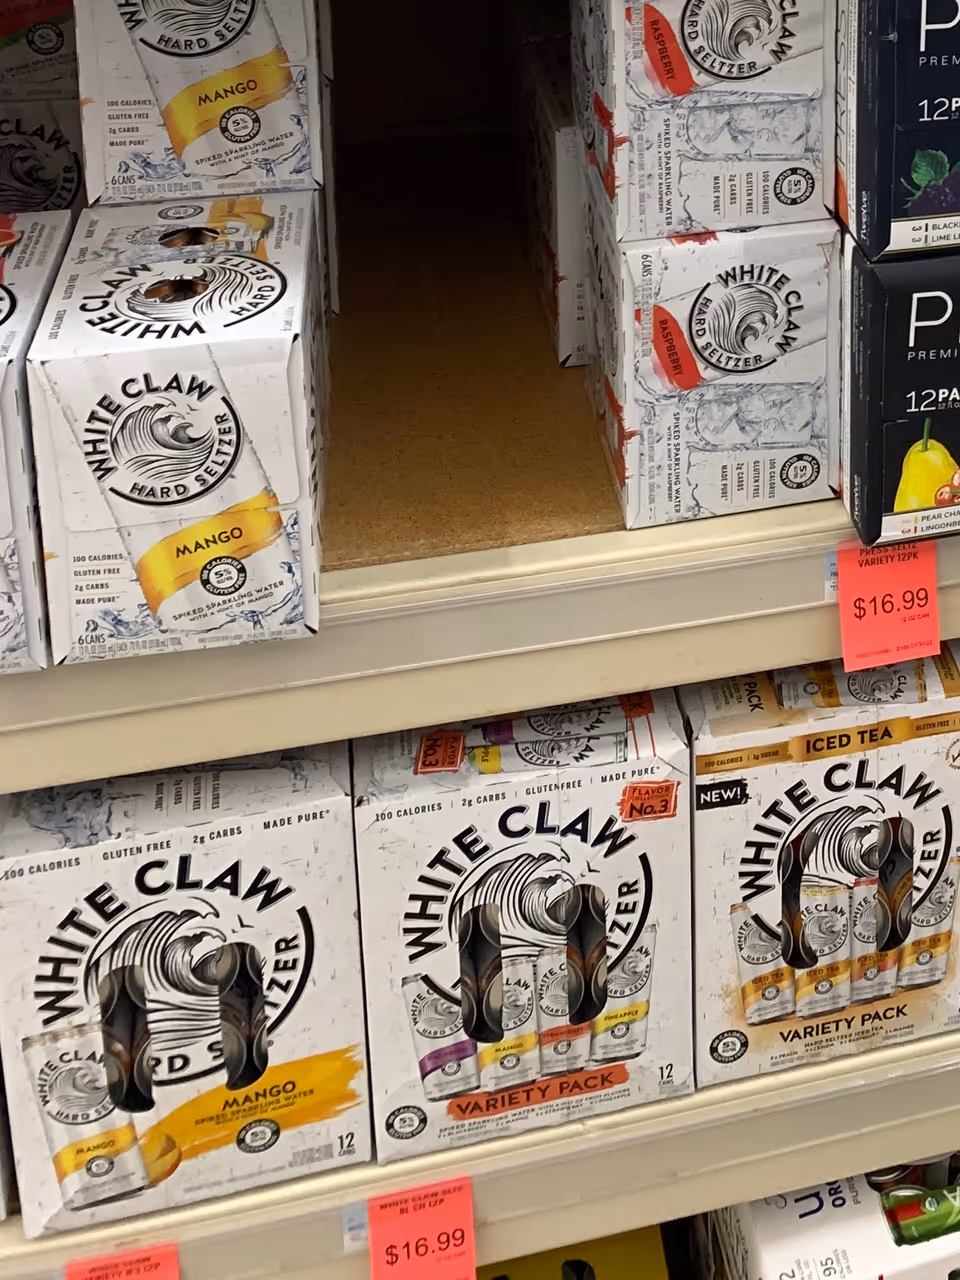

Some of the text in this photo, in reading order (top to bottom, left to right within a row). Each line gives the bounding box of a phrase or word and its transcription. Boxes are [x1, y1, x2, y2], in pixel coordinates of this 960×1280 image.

[651, 18, 677, 81] RASPBERRY
[197, 79, 258, 107] MANGO
[932, 233, 951, 243] LIME
[83, 372, 215, 480] WHITE CLAW
[131, 412, 227, 499] HARD SELTZER
[922, 513, 941, 523] PEAR
[175, 526, 243, 559] MANGO
[853, 588, 928, 621] $16.99
[805, 726, 893, 754] ICED TEA
[700, 786, 741, 803] NEW!
[401, 800, 639, 963] WHITE CLAW
[221, 1078, 297, 1112] MANGO
[454, 1069, 615, 1119] VARIETY PACK
